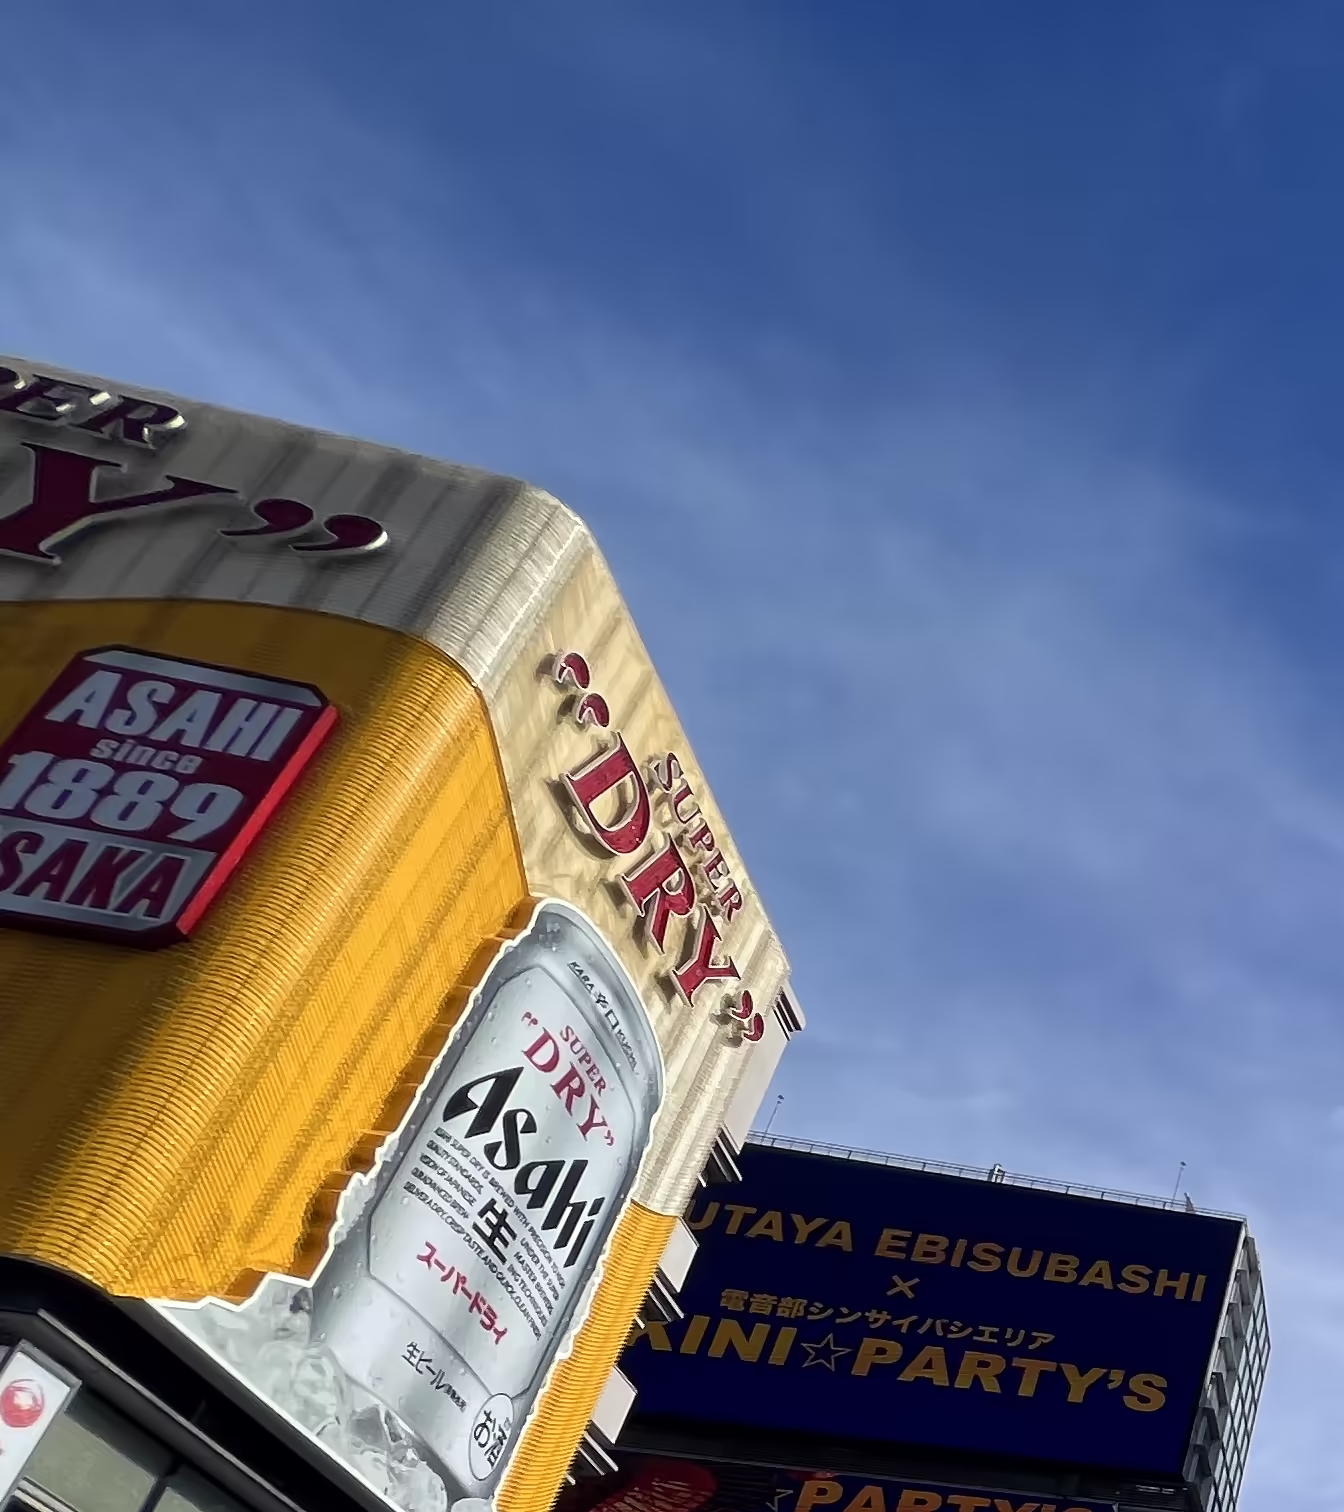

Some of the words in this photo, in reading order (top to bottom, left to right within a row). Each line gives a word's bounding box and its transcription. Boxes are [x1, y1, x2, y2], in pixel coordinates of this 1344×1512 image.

[46, 669, 302, 762] ASAHI
[88, 737, 205, 775] since
[0, 751, 245, 844] 1889
[656, 752, 743, 920] SUPER
[559, 1024, 609, 1092] SUPER
[442, 1066, 606, 1268] Asahi
[472, 1198, 518, 1265] 生
[874, 1227, 1210, 1303] EBISUBASHI
[417, 1241, 507, 1345] スーパードライ
[719, 1288, 1056, 1350] 電音部シンサイバシエリア
